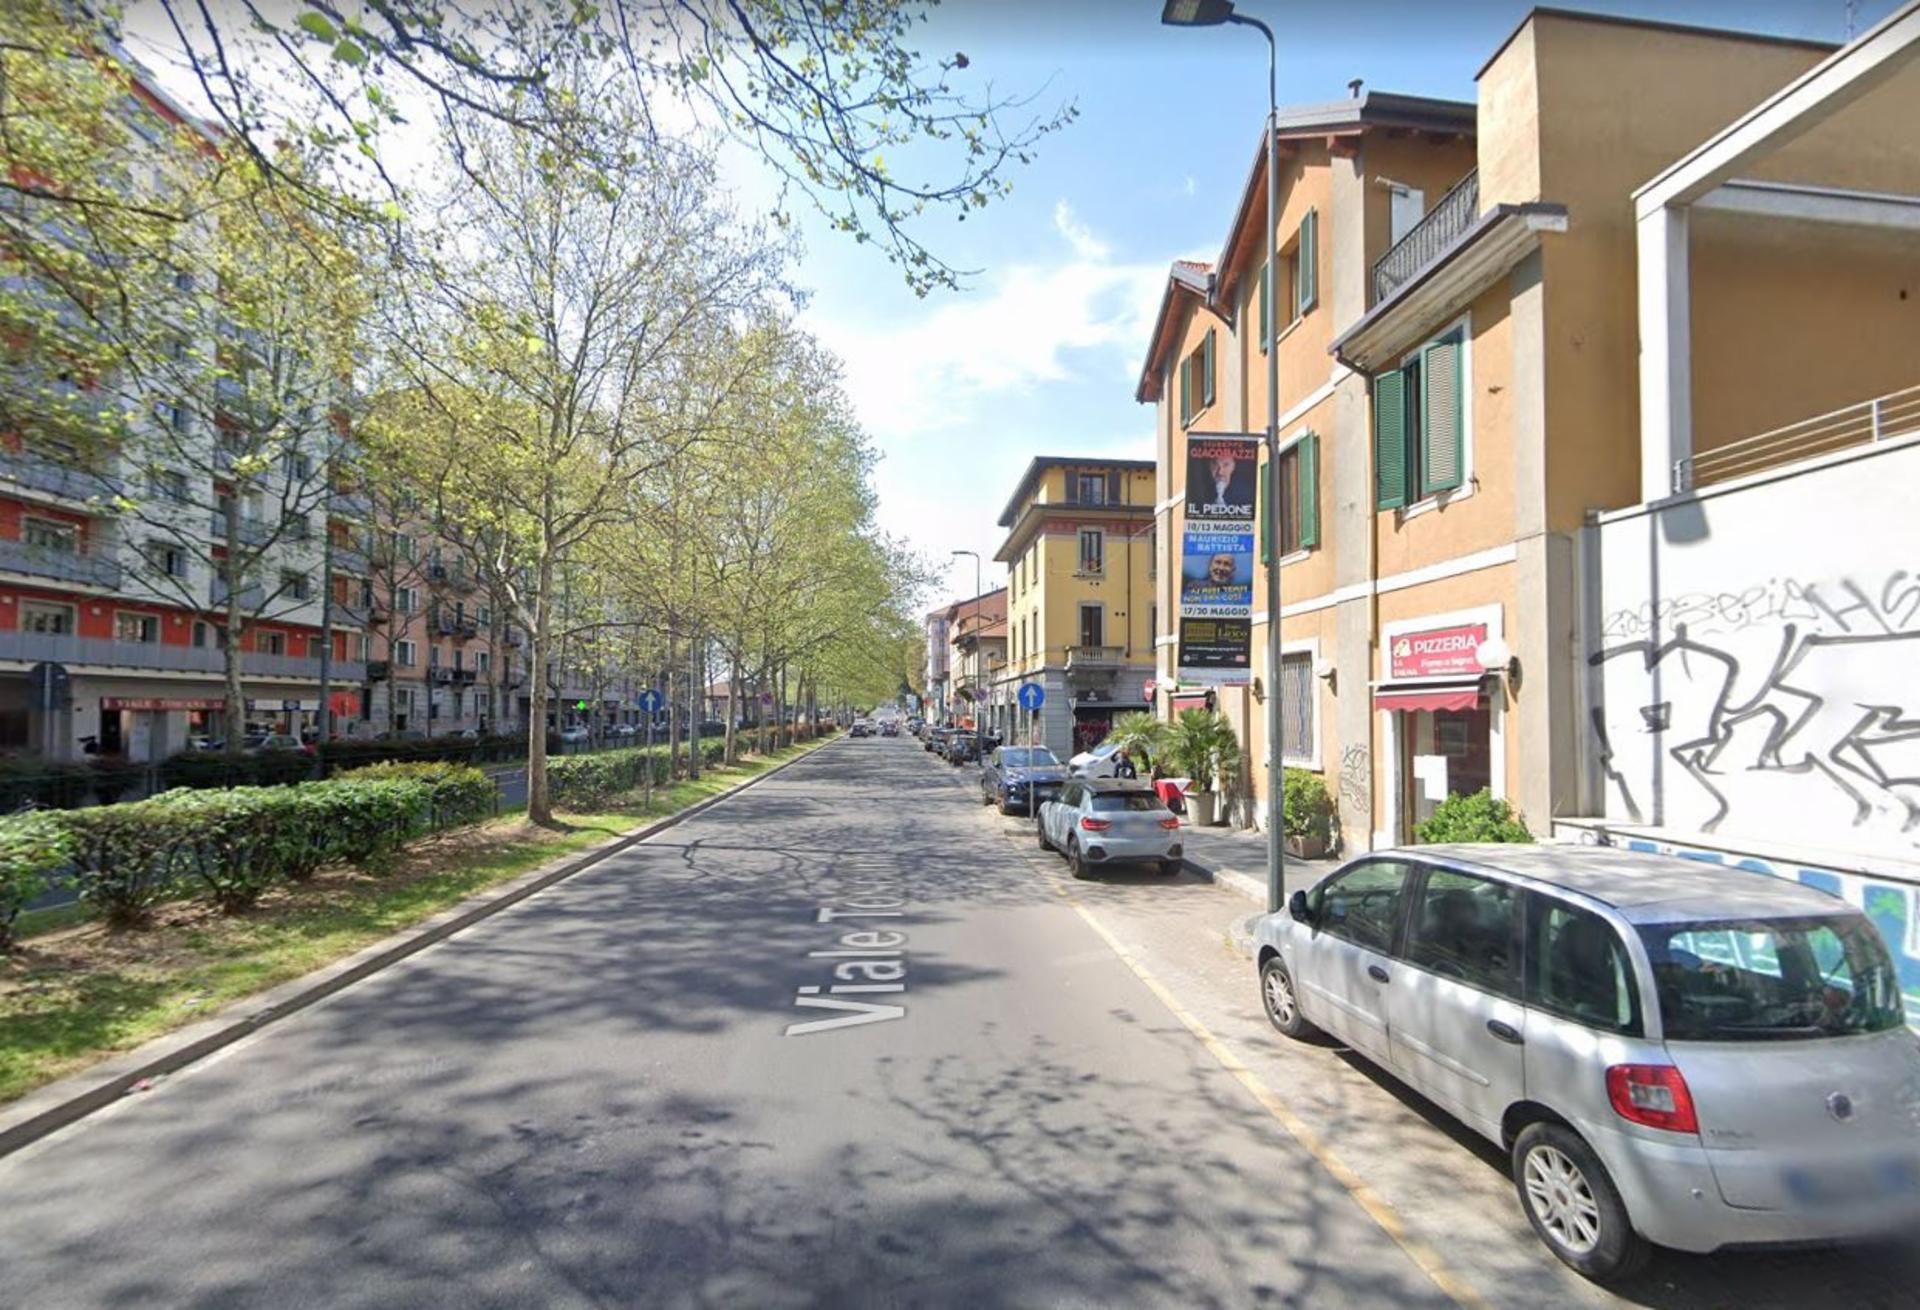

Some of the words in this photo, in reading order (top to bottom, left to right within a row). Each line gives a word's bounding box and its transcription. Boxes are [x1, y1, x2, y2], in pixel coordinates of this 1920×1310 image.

[1188, 503, 1200, 514] IL
[1202, 503, 1253, 515] PEDONE
[1213, 523, 1252, 532] MAGGIO
[1188, 534, 1240, 543] MAURIZIO
[1196, 543, 1246, 552] BATTISTA
[1184, 607, 1208, 616] 17/20
[1210, 607, 1249, 616] MAGGIO
[1414, 635, 1478, 654] PIZZERIA
